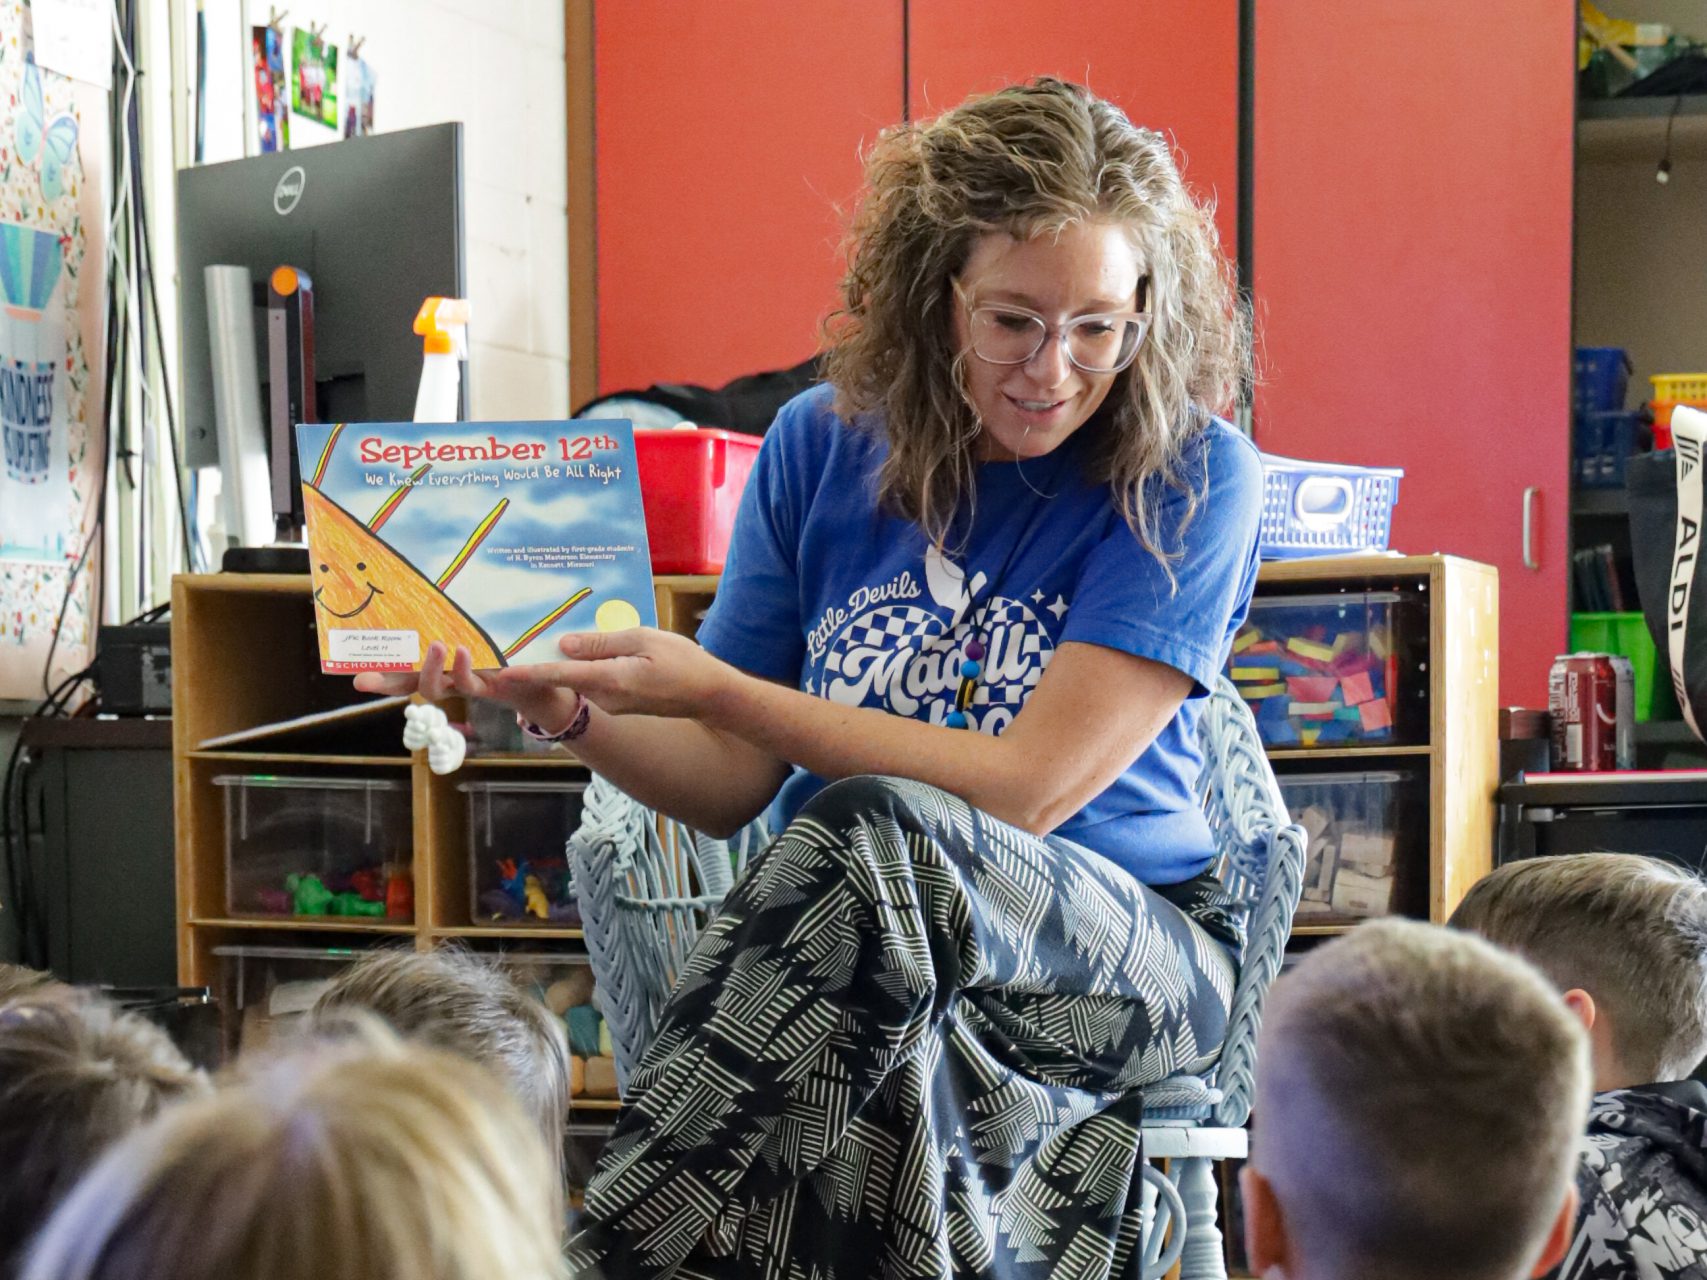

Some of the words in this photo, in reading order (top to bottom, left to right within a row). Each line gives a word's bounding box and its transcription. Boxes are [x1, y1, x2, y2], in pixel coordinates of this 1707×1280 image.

[360, 435, 546, 469] September
[558, 434, 619, 460] 12th
[365, 472, 384, 486] We
[389, 471, 423, 486] Knew
[428, 471, 500, 488] Everything
[503, 467, 539, 481] Would
[544, 464, 560, 478] Be
[566, 465, 584, 478] All
[589, 463, 622, 484] Right
[506, 553, 514, 561] of
[513, 545, 525, 554] and
[561, 545, 570, 554] by
[1671, 516, 1698, 632] ALDI
[807, 606, 848, 667] Little
[848, 571, 921, 617] Devils
[335, 661, 411, 669] SCHOLASTIC
